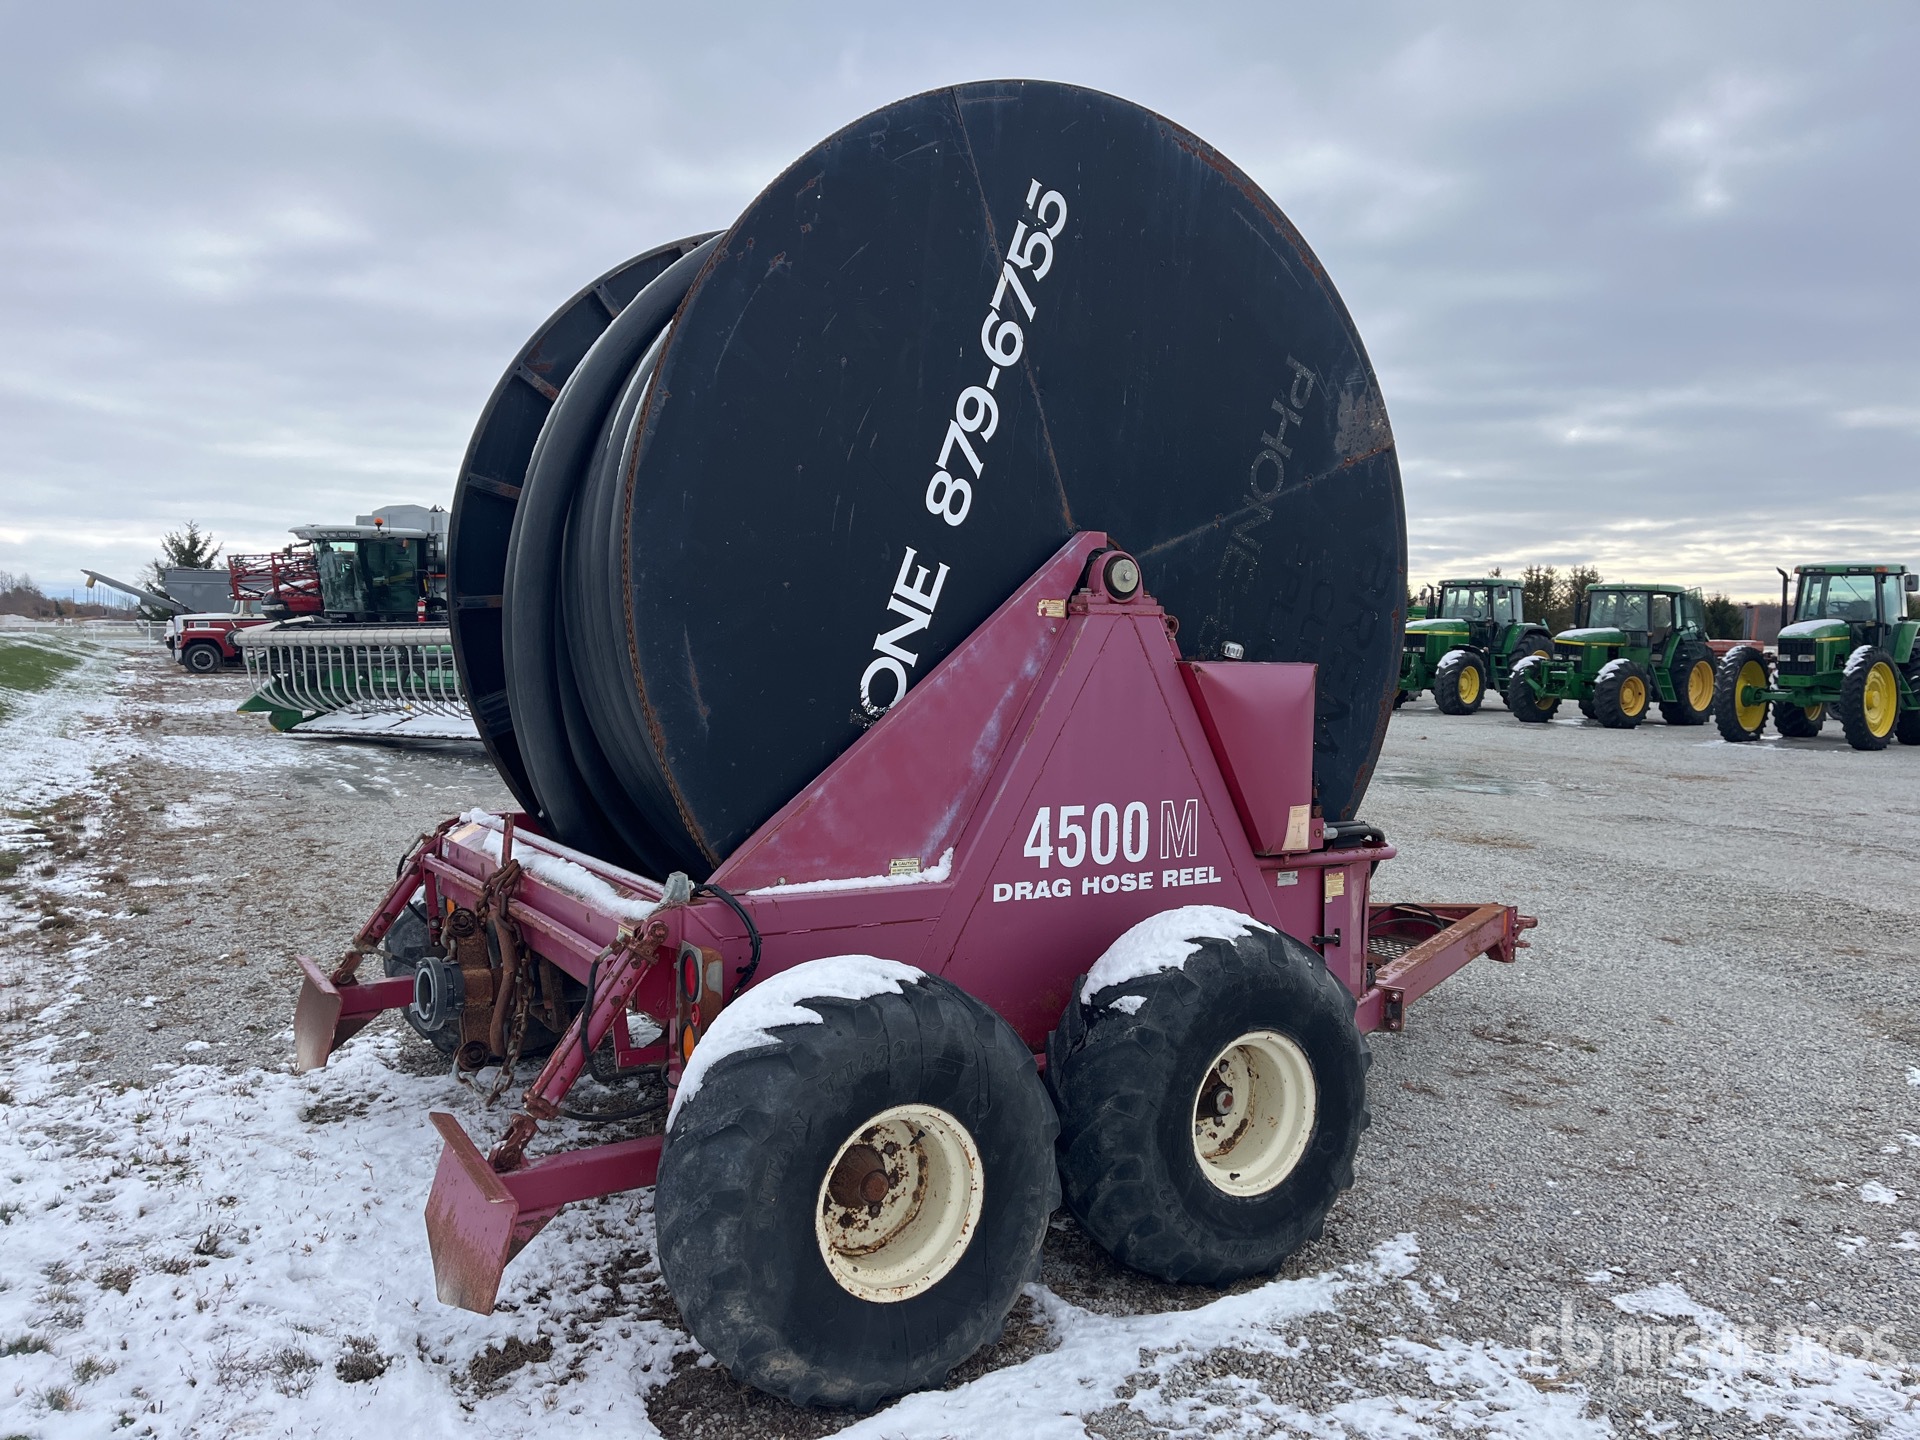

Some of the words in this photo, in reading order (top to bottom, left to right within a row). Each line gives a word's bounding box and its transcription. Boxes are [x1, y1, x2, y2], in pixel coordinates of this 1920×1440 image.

[850, 545, 950, 729] ONE
[926, 177, 1068, 527] 879-6755
[1217, 352, 1317, 594] PHONE
[993, 878, 1071, 903] DRAG
[1081, 871, 1154, 896] HOSE
[1162, 866, 1222, 888] REEL
[1023, 801, 1149, 869] 4500
[1160, 798, 1199, 860] M
